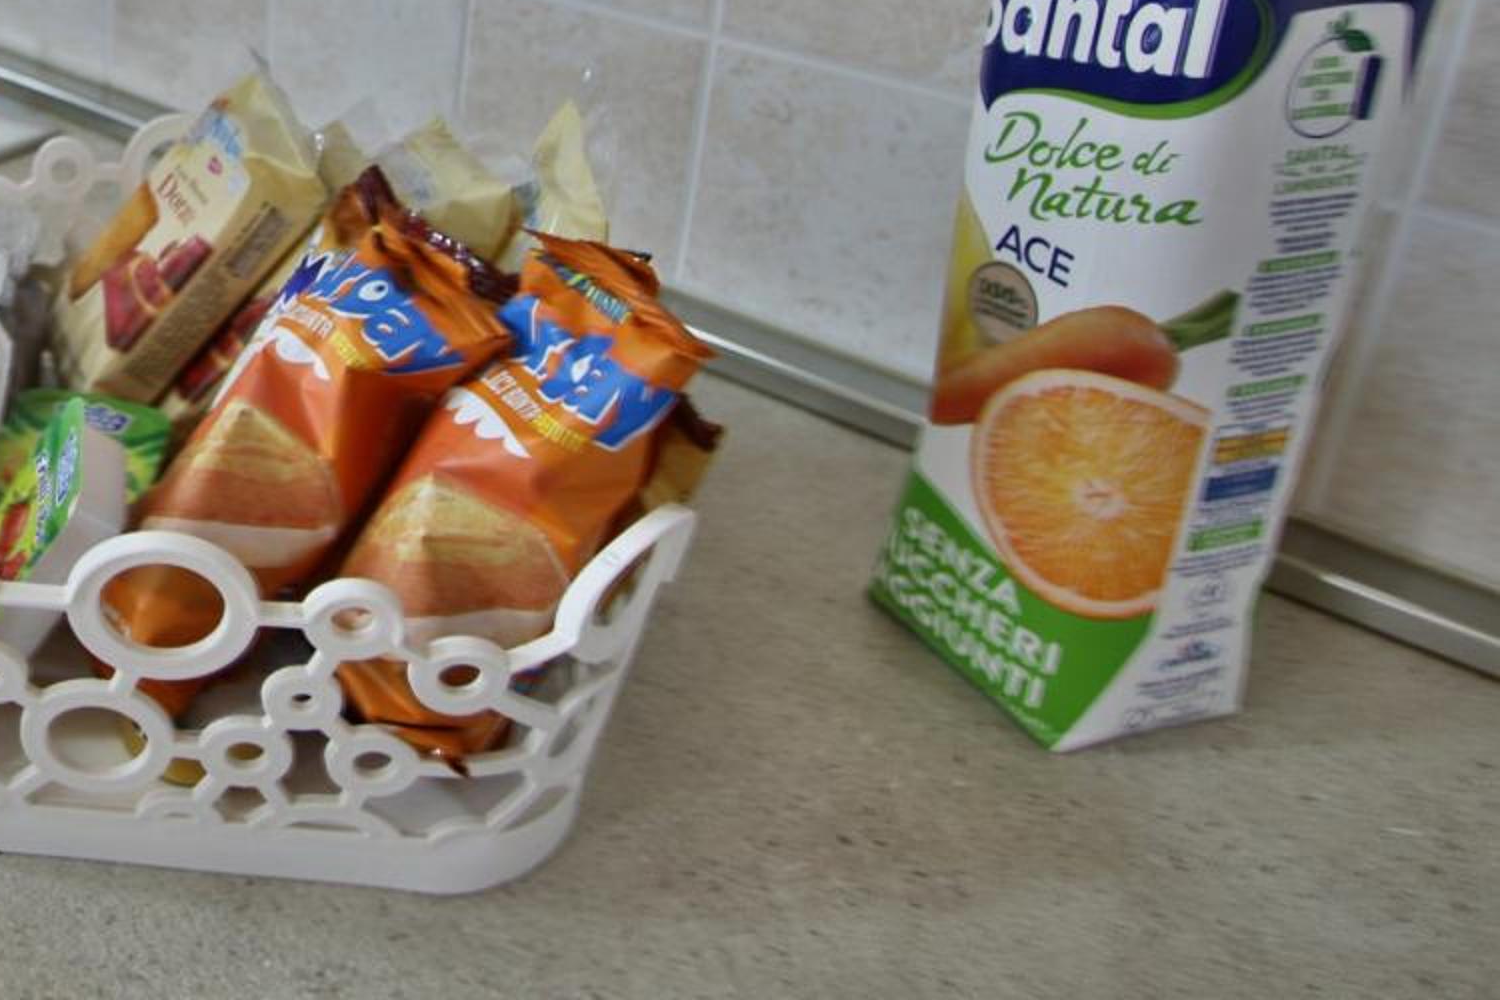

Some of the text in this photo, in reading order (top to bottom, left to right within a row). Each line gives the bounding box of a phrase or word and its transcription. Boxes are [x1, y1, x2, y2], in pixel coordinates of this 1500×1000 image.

[984, 110, 1185, 176] Dolce di
[1006, 167, 1203, 226] Natura
[995, 224, 1076, 288] ACE
[904, 507, 1022, 618] SENZA
[890, 528, 1062, 676] UCCHERI
